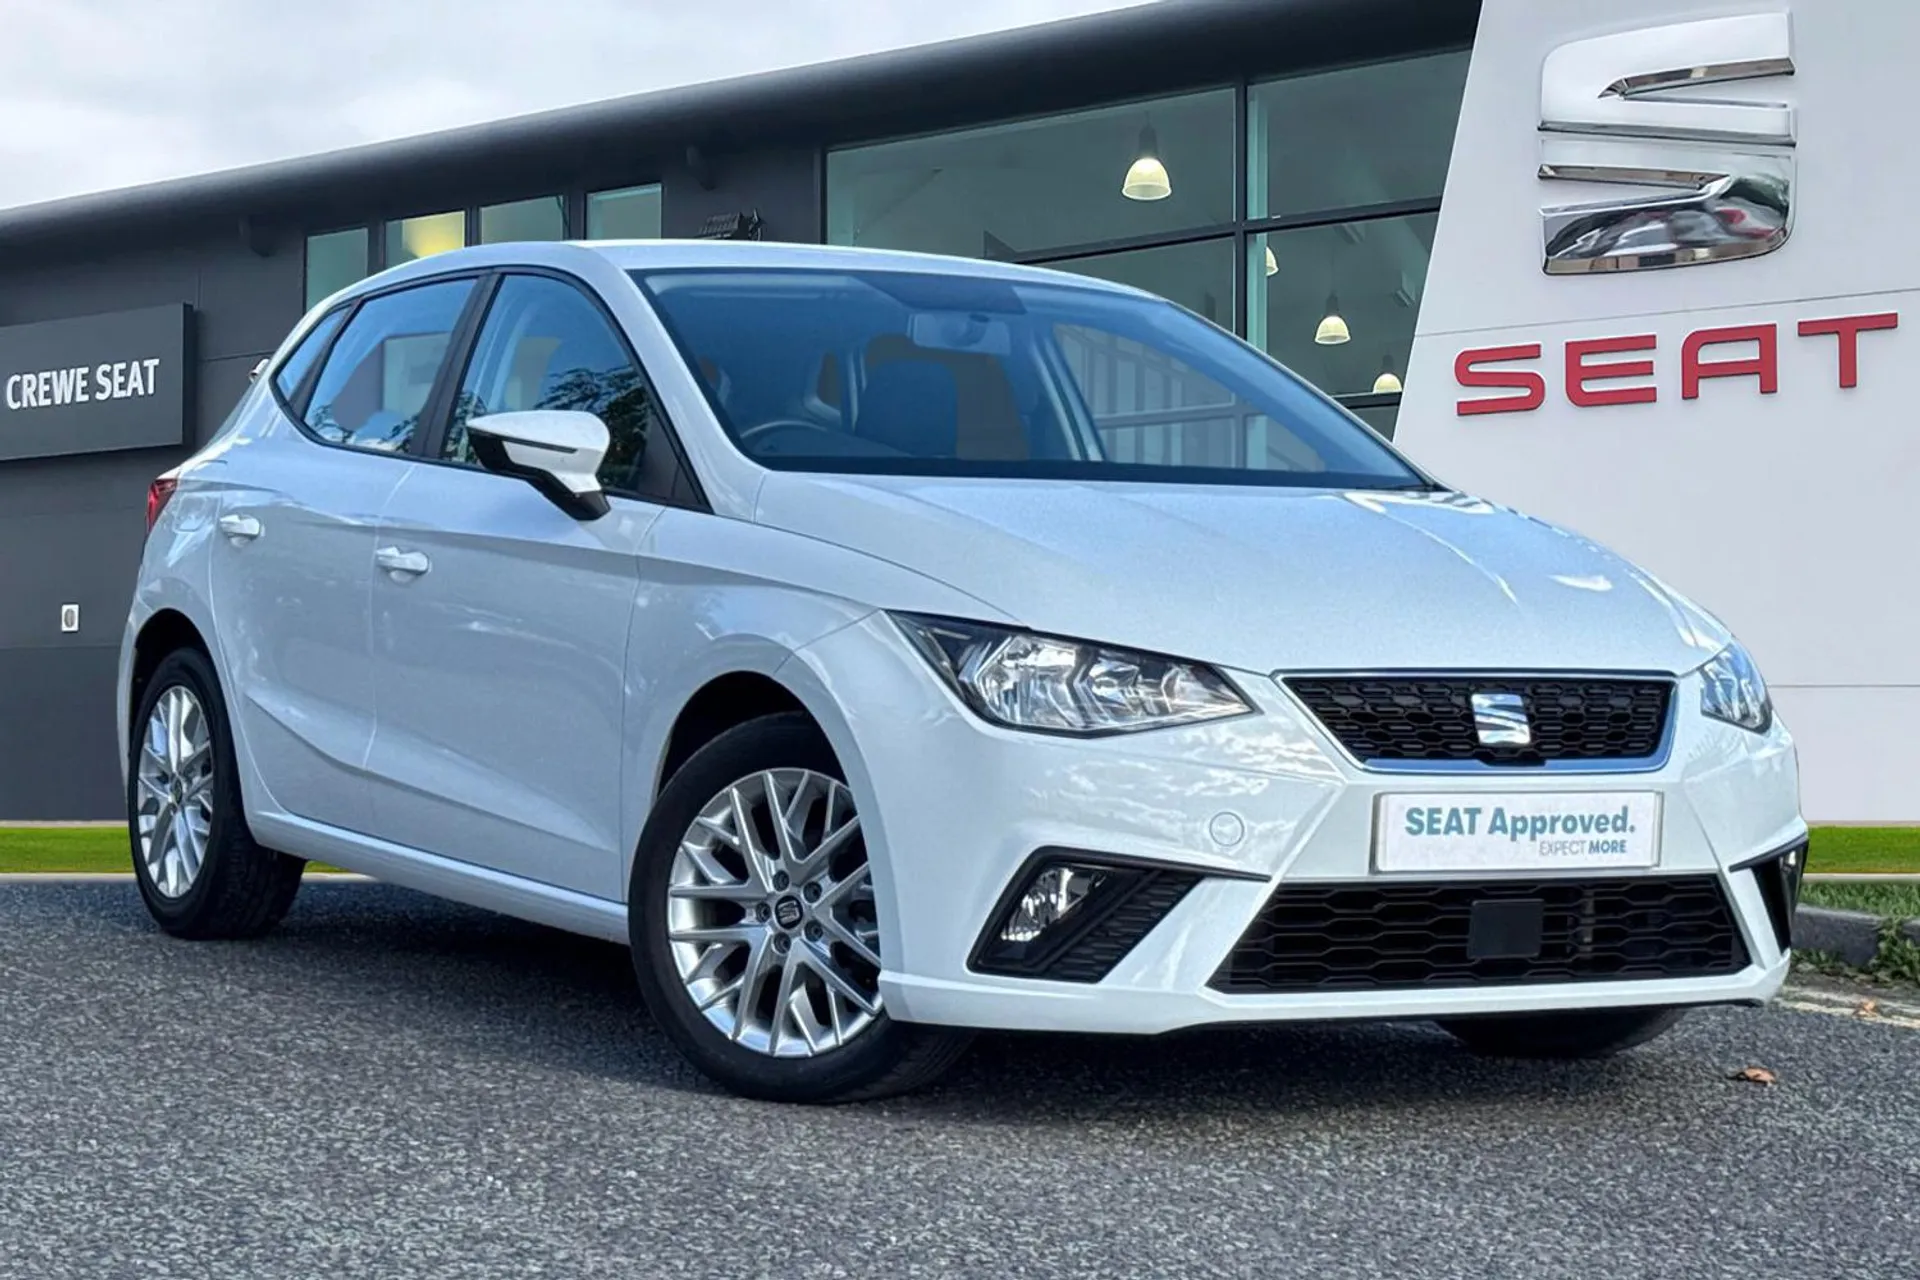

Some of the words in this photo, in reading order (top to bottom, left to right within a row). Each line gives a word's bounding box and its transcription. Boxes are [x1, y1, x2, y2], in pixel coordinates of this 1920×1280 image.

[6, 367, 90, 410] CREWE
[95, 358, 160, 401] SEAT
[1454, 312, 1898, 416] SEAT
[1405, 807, 1482, 836] SEAT
[1487, 805, 1636, 842] Approved.
[1539, 840, 1587, 857] EXPECT
[1588, 839, 1627, 854] MORE
